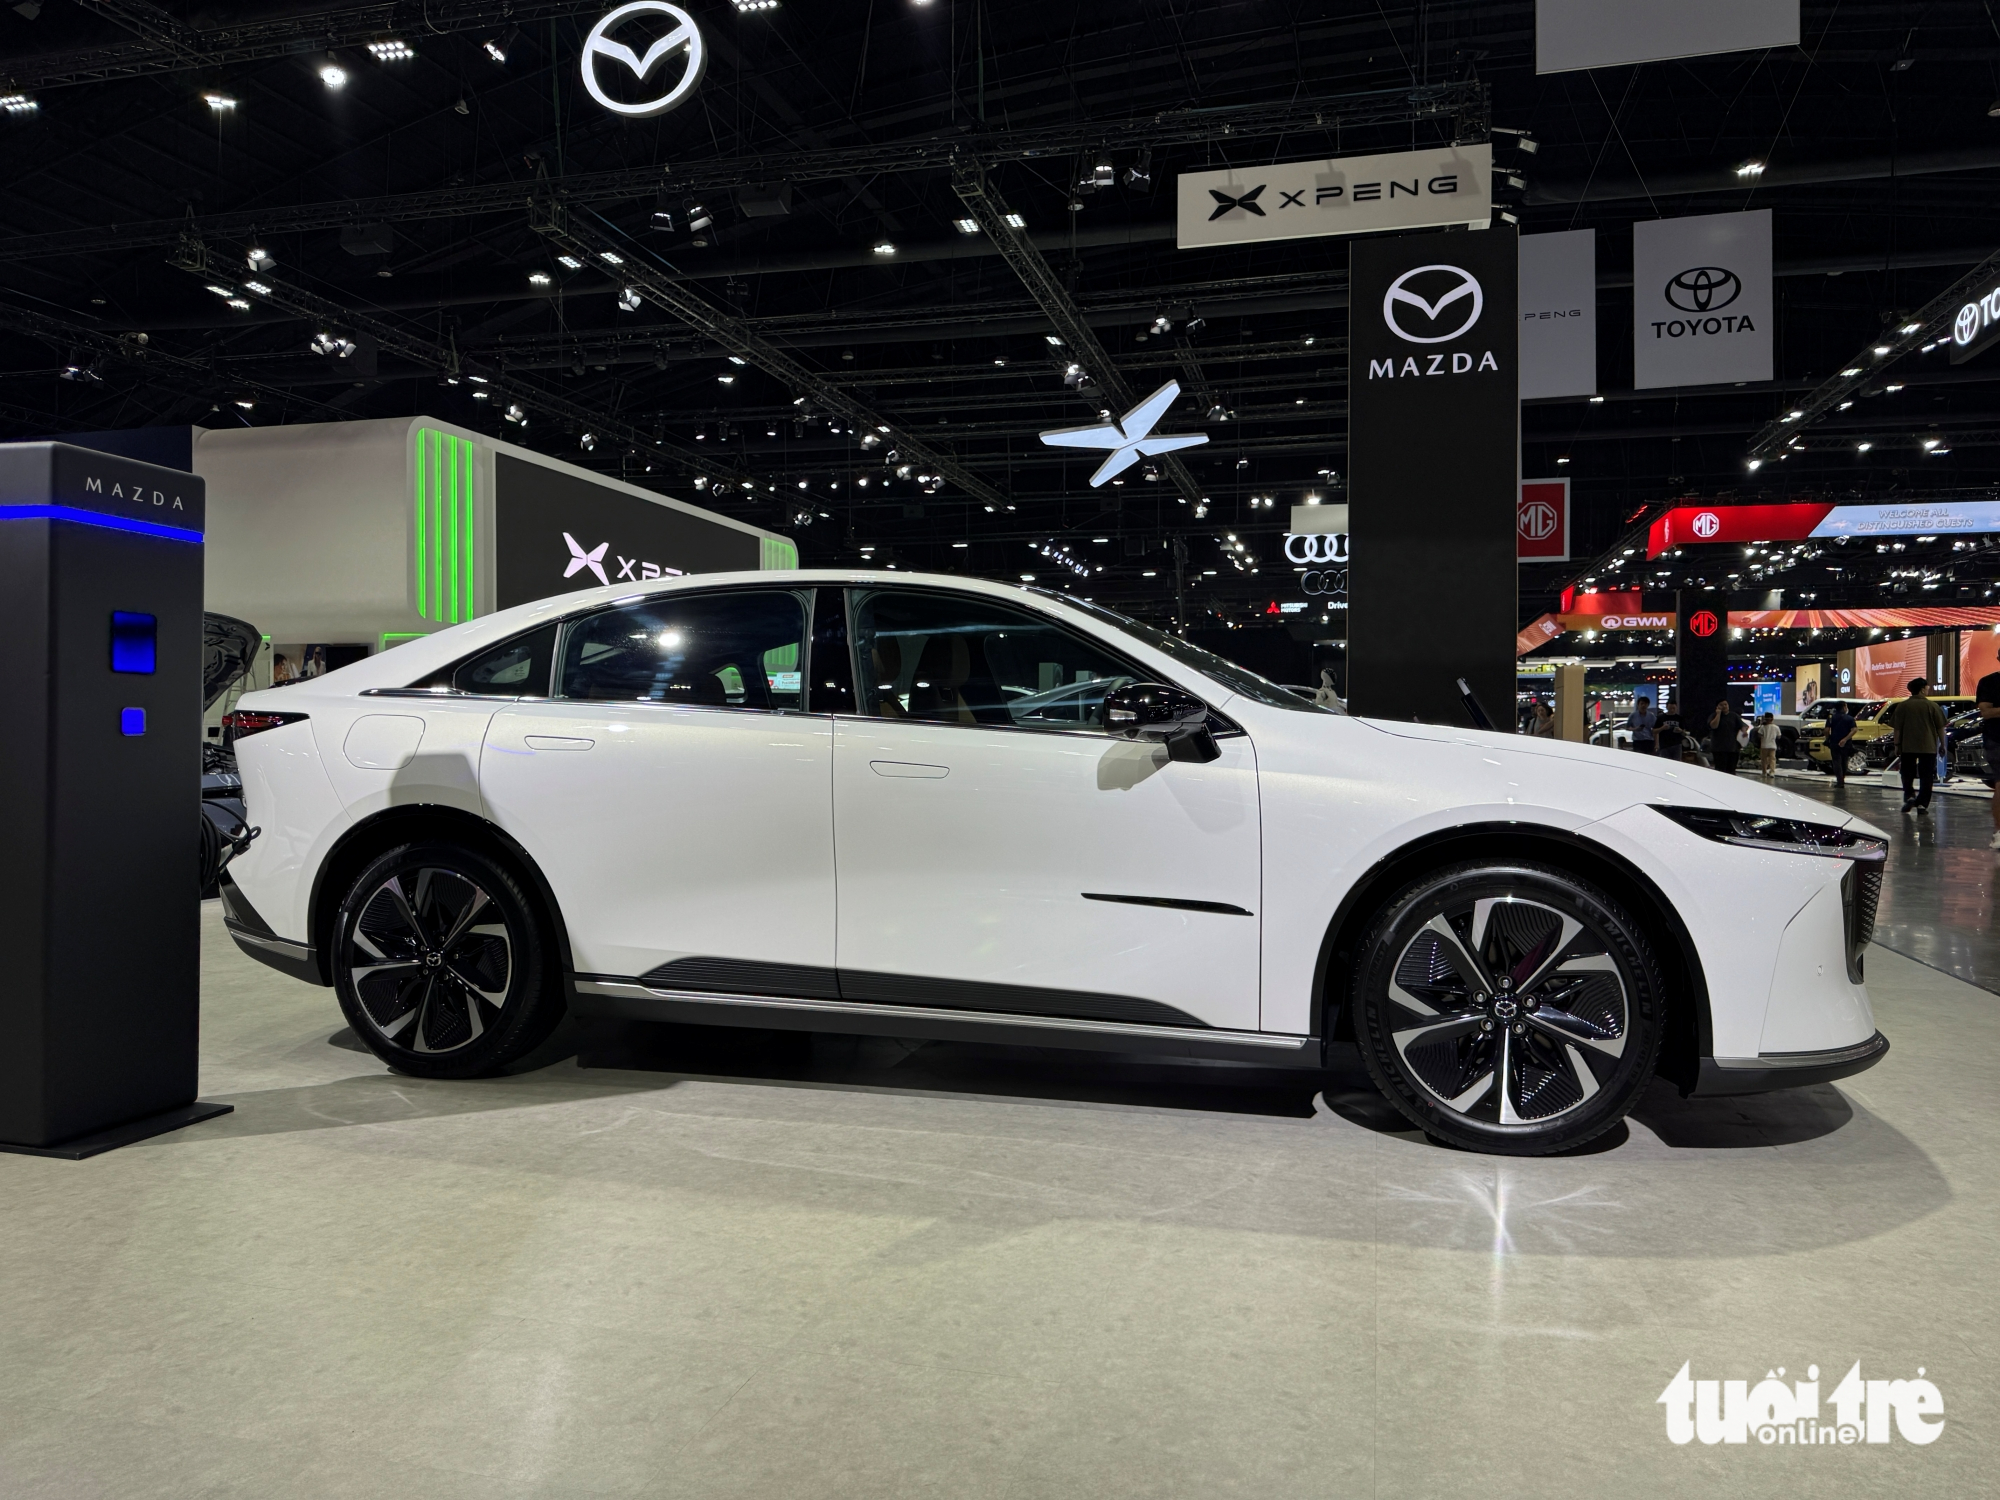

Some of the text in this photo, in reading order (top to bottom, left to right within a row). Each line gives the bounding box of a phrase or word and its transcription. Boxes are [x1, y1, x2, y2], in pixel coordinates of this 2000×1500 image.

[1279, 174, 1458, 211] XPENG
[1520, 309, 1581, 321] PENG
[1651, 315, 1756, 339] TOYOTA
[1368, 351, 1499, 380] MAZDA
[86, 476, 185, 510] MAZDA
[1519, 504, 1555, 538] MG
[1694, 514, 1718, 536] MG
[1858, 518, 1974, 531] DISTINGUISHED GUESTS
[1879, 508, 1949, 519] WELCOME ALL
[1623, 616, 1667, 627] GWM
[1691, 612, 1717, 635] MG
[1603, 920, 1654, 1016] MICHELIN
[1366, 1006, 1414, 1097] MICHELIN
